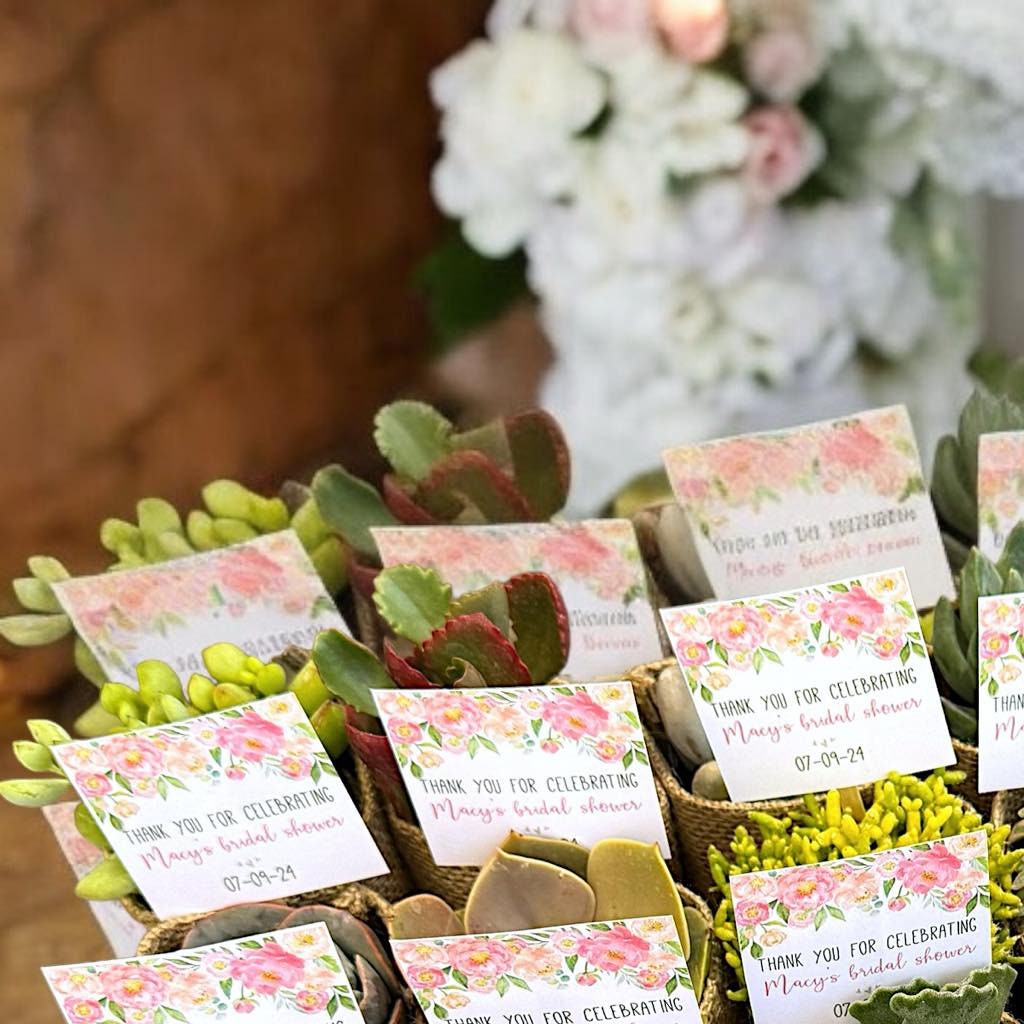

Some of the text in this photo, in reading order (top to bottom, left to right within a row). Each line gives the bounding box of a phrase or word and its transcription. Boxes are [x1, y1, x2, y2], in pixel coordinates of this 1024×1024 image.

[709, 667, 918, 719] THANK YOU FOR CELEBRATING
[722, 697, 922, 746] Macy's bridal shower
[794, 745, 865, 772] 07-09-24
[419, 773, 639, 795] THANK YOU FOR CELEBRATING
[122, 786, 335, 845] THANK YOU FOR CELEBRATING
[431, 796, 643, 824] Macy's bridal shower
[140, 816, 345, 871] Macy's bridal shower
[222, 864, 297, 893] 07-09-24
[757, 917, 977, 974] THANK YOU FOR CELEBRATING
[764, 944, 977, 998] Macy's bridal shower
[582, 998, 684, 1022] CELEBRATING
